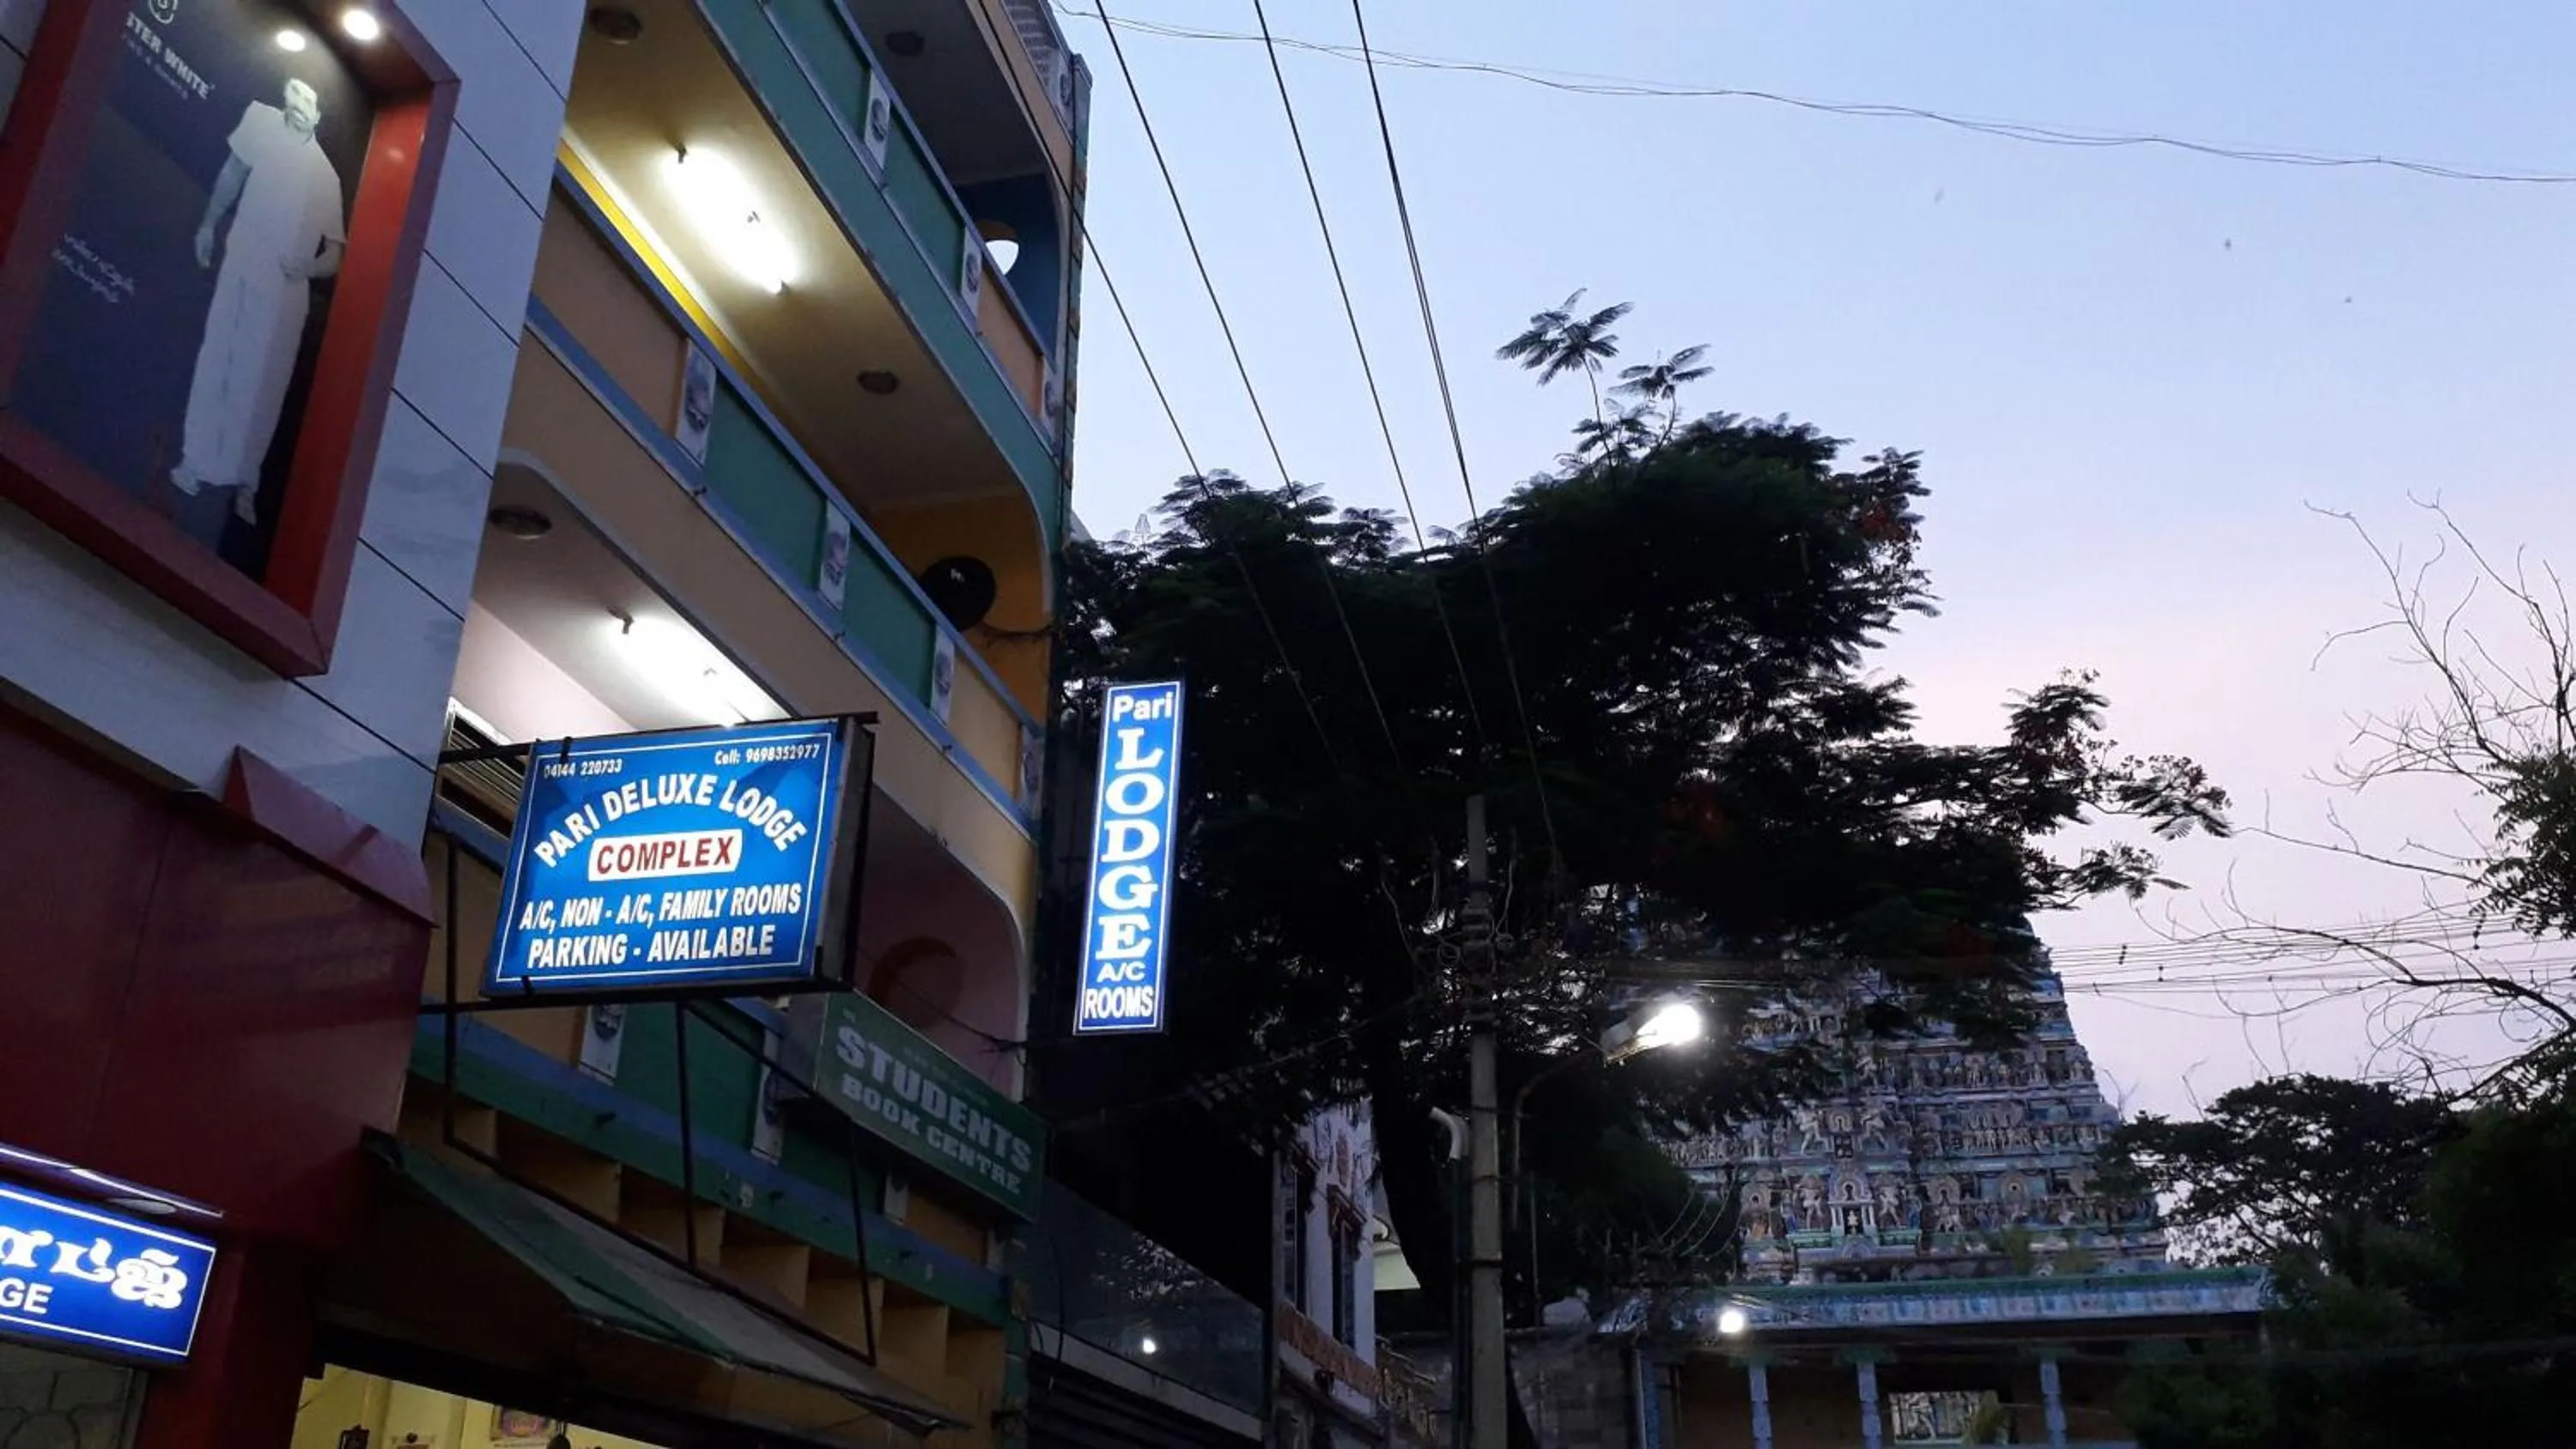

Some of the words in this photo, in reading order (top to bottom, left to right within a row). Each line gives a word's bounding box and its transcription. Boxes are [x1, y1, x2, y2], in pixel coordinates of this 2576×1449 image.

[1113, 692, 1173, 722] Pari
[580, 758, 623, 776] 220733
[714, 748, 740, 765] Call:
[534, 803, 601, 868] PARI
[602, 773, 718, 822] DELUXE
[719, 779, 808, 852] LODGE
[596, 834, 735, 876] COMPLEX
[1096, 728, 1165, 961] LODGE
[519, 900, 556, 933] A/C,
[561, 896, 605, 928] NON
[616, 894, 653, 929] A/C,
[659, 888, 727, 921] FAMILY
[731, 882, 802, 915] ROOMS
[527, 933, 628, 968] PARKING
[647, 925, 776, 962] AVAILABLE
[1097, 961, 1146, 983] A/C
[1084, 985, 1153, 1019] ROOMS
[836, 1026, 1031, 1173] STUDENTS
[841, 1073, 920, 1136] BOOK
[926, 1125, 1020, 1194] CENTRE
